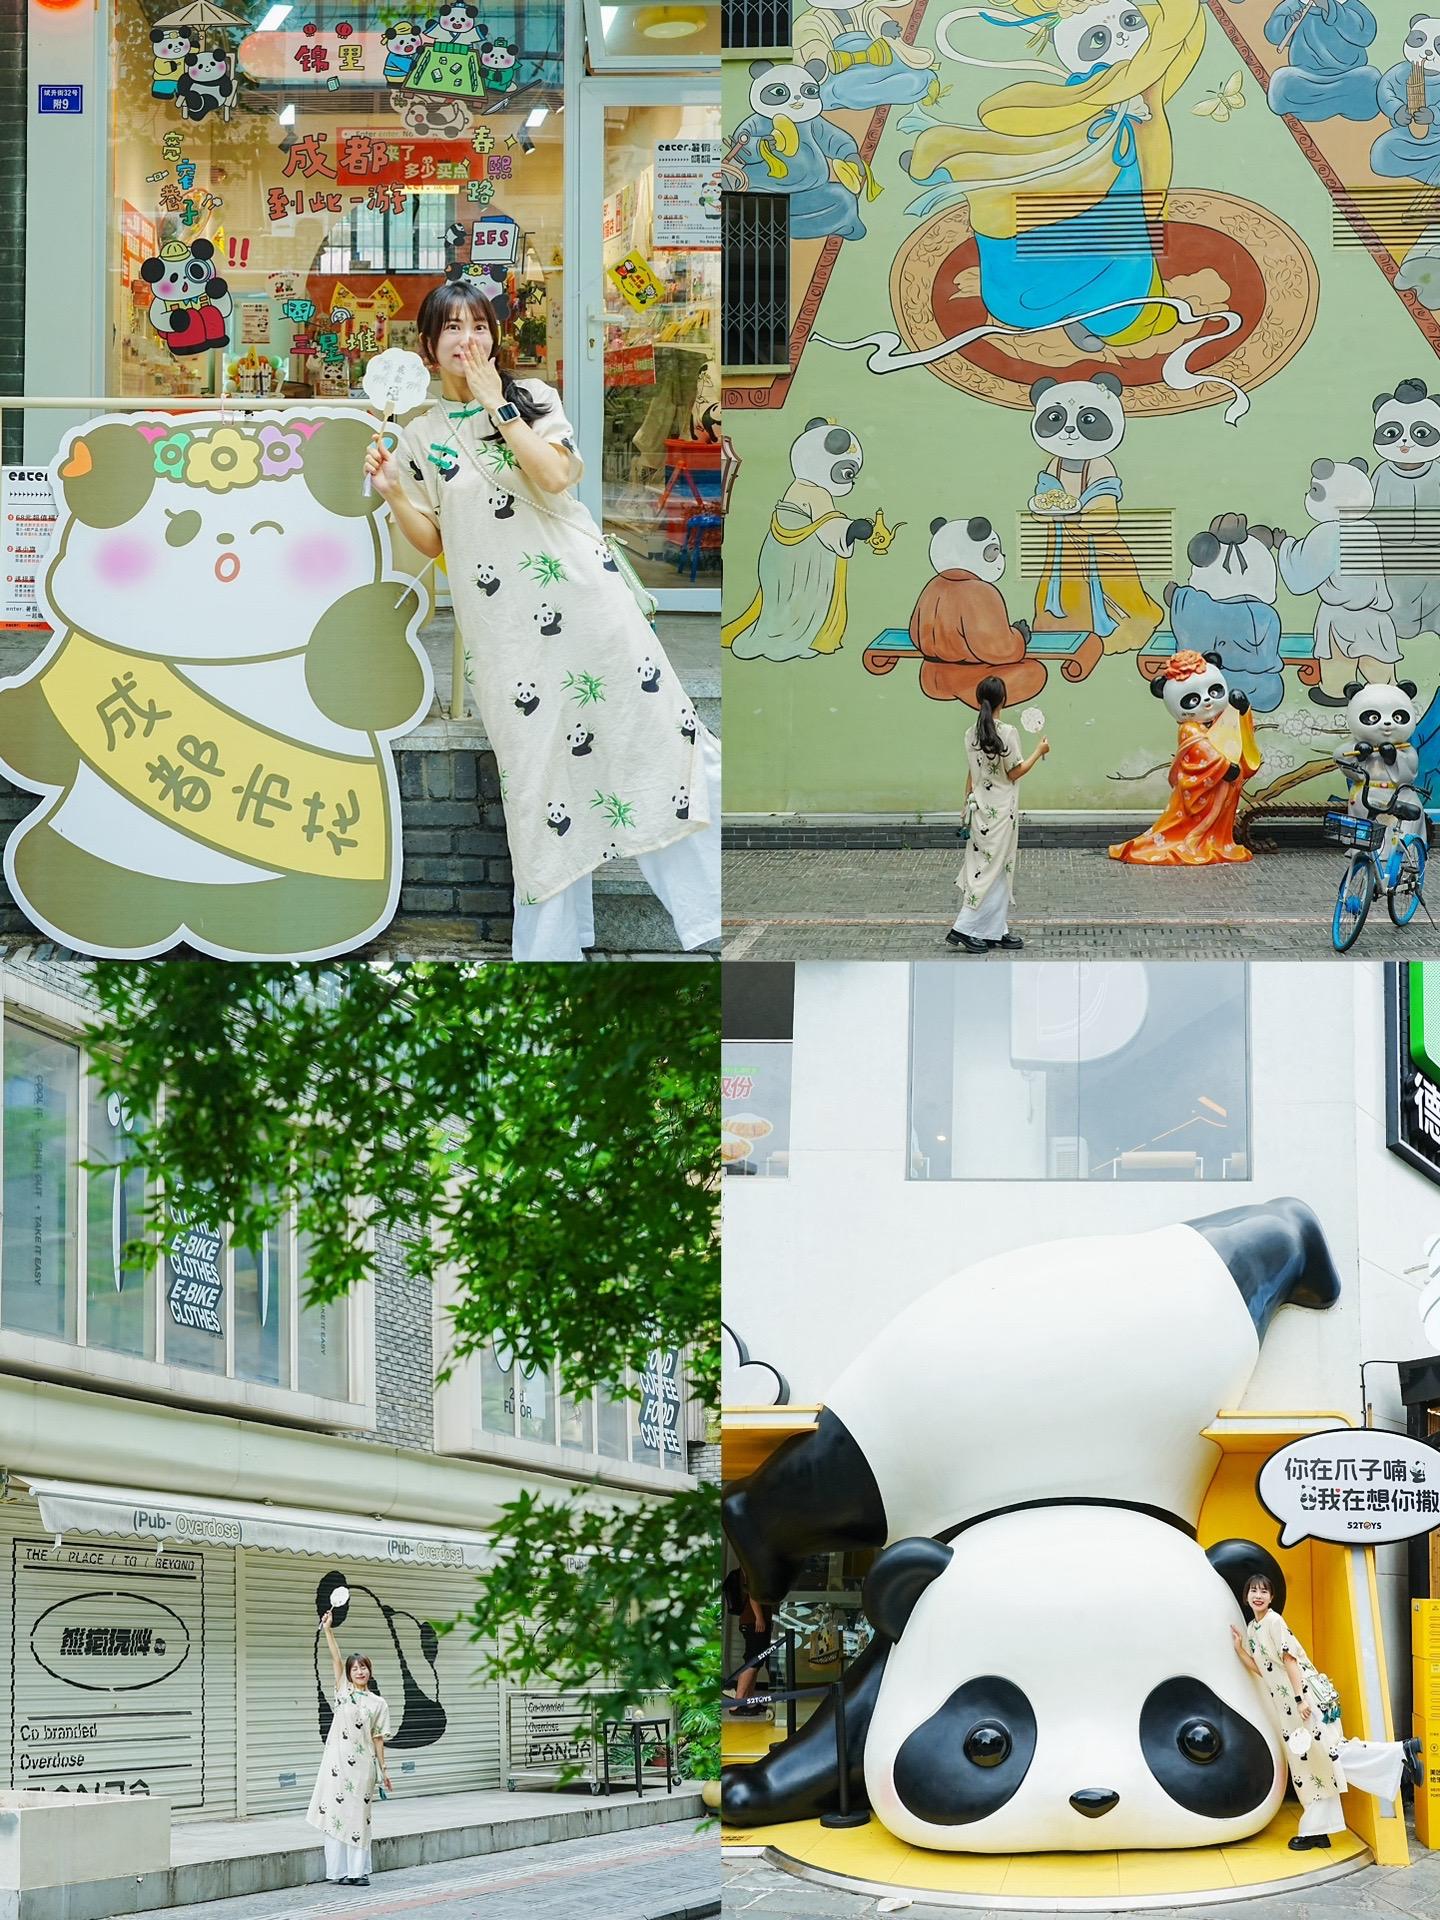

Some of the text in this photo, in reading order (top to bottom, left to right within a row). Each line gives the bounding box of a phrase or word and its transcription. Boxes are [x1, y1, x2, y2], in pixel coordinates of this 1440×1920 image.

[294, 45, 365, 73] 锦里
[53, 99, 69, 110] 附9
[282, 133, 388, 179] 成都
[404, 156, 470, 180] 多少买点
[466, 126, 513, 204] 春熙路
[159, 131, 199, 226] 宽窄巷子
[267, 182, 406, 220] 到此一游
[475, 230, 509, 246] IFS
[290, 330, 379, 363] 三星堆
[96, 671, 361, 856] 成都市花
[34, 1215, 42, 1243] TAKE
[34, 1245, 42, 1256] IT
[170, 1231, 220, 1261] E-BIKE
[34, 1257, 42, 1286] EASY
[170, 1253, 220, 1286] CLOTHES
[170, 1278, 220, 1308] E-BIKE
[170, 1300, 221, 1332] CLOTHES
[509, 1387, 525, 1403] 2d
[504, 1400, 532, 1419] FLOR
[1284, 1457, 1407, 1482] 你在爪子喃
[1318, 1487, 1440, 1513] 我在想你撒
[1347, 1521, 1382, 1530] 52TOYS
[26, 1548, 49, 1562] THE
[68, 1551, 105, 1565] PLACE
[124, 1555, 138, 1567] TO
[155, 1557, 196, 1571] BEYOND
[746, 1695, 772, 1704] 52TOYS
[20, 1752, 86, 1770] Overdose
